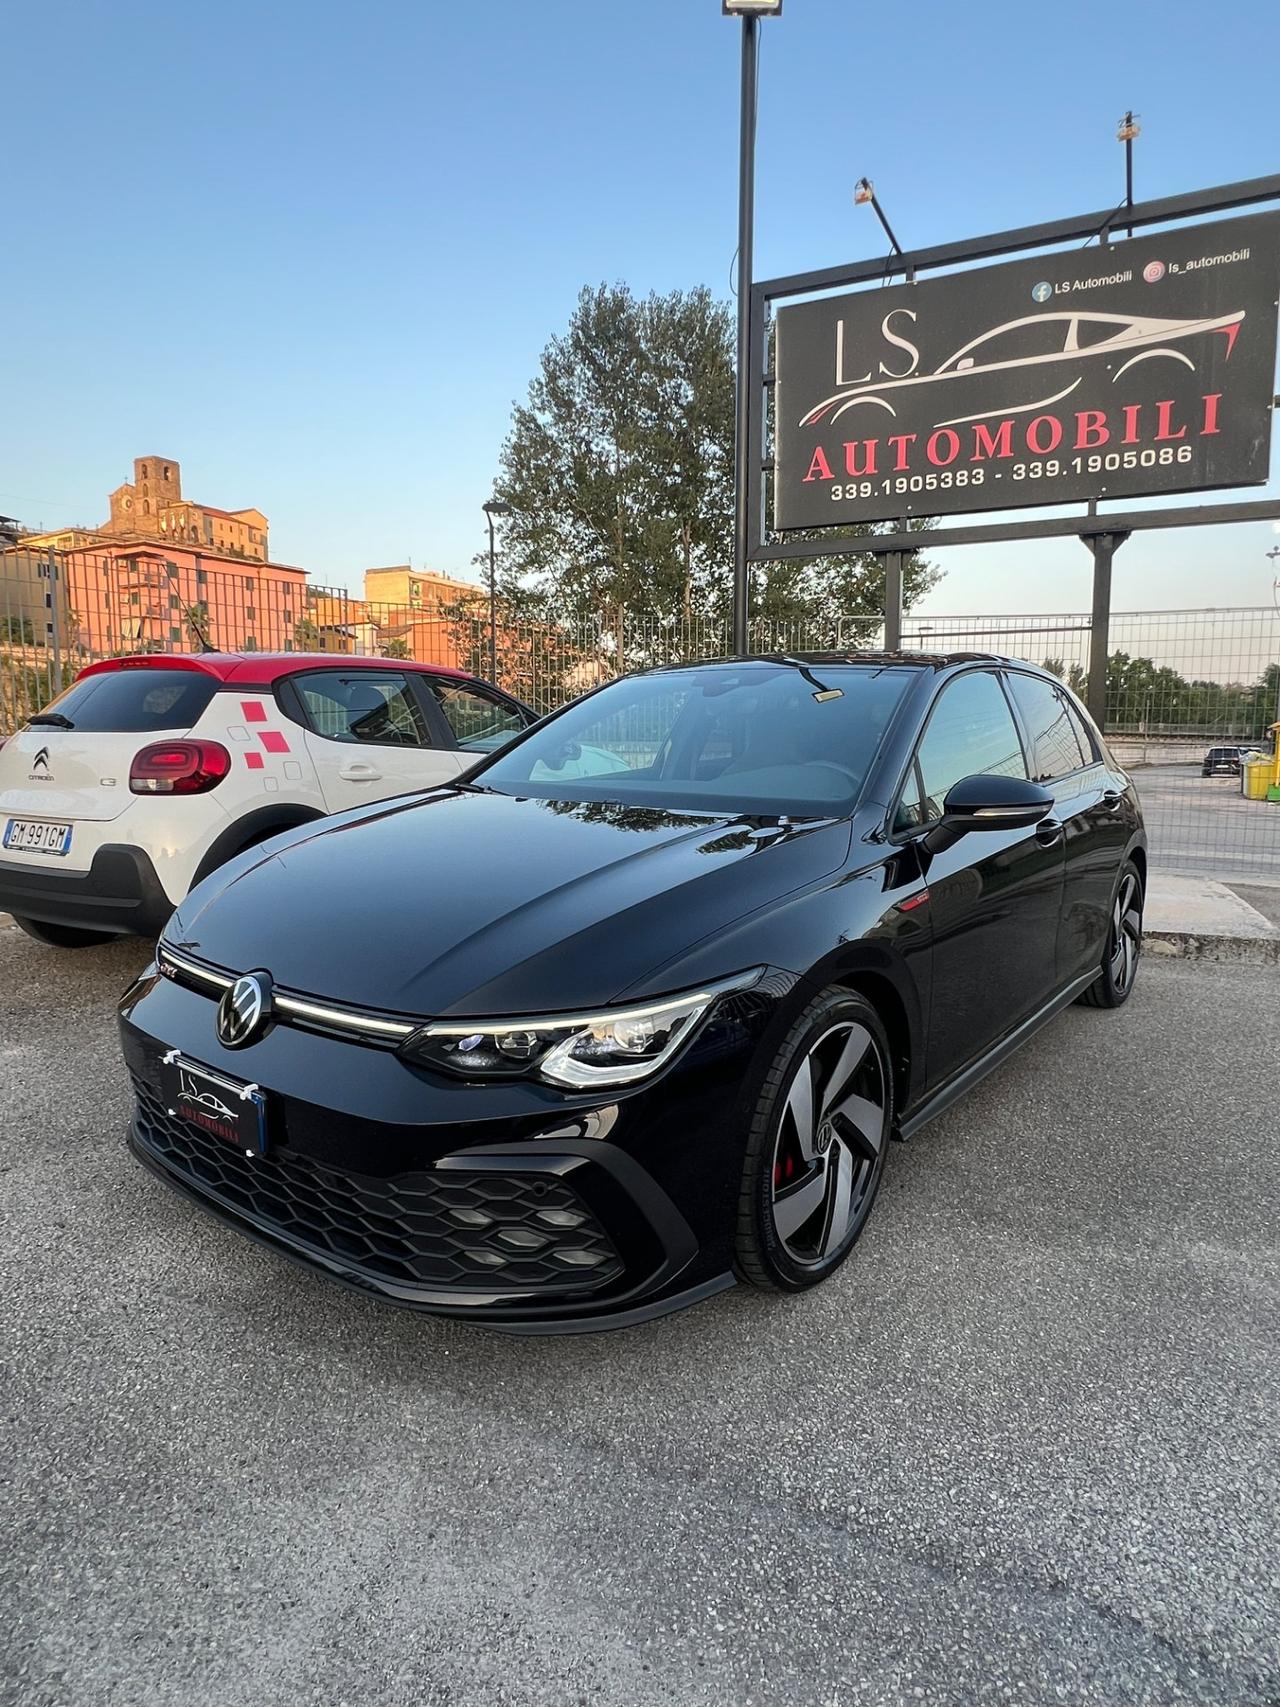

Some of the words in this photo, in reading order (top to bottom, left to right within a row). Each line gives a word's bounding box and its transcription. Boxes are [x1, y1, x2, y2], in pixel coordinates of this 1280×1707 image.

[1055, 281, 1070, 294] LS
[1072, 270, 1133, 291] Automobili
[835, 308, 919, 386] LS
[802, 393, 1223, 482] AUTOMOBILI
[830, 468, 985, 501] 339.1905383
[1012, 445, 1192, 482] 339.1905086
[180, 1104, 240, 1143] AUTOMOBILI
